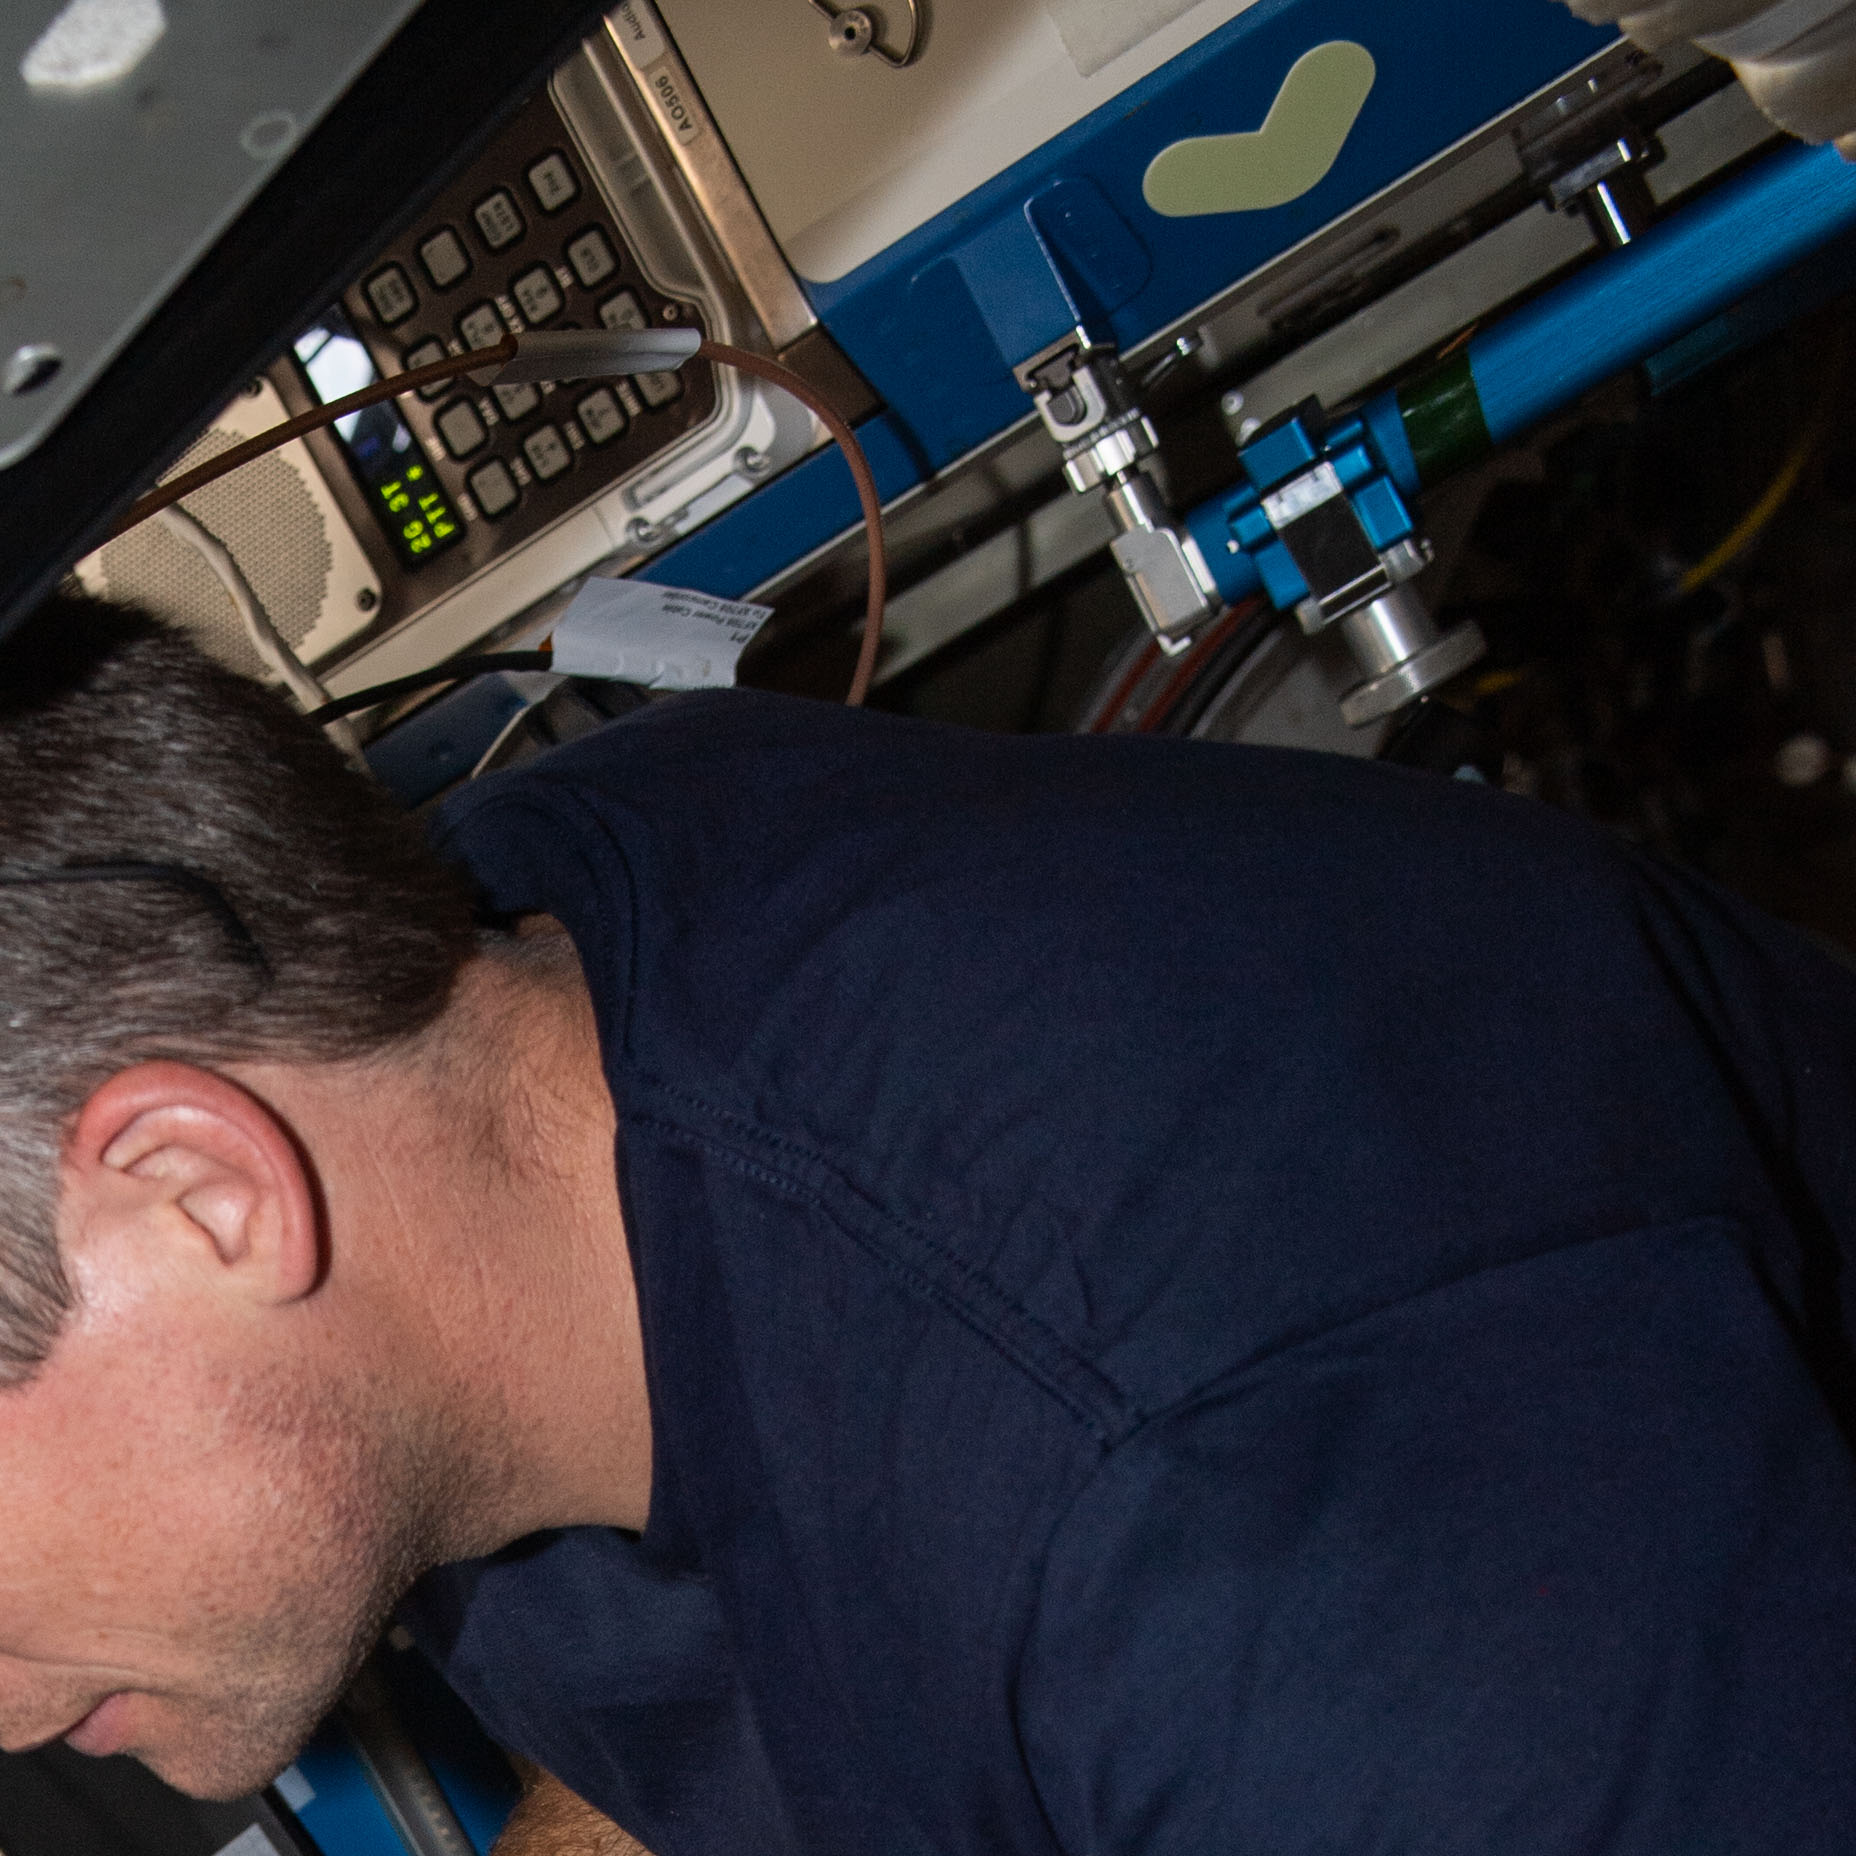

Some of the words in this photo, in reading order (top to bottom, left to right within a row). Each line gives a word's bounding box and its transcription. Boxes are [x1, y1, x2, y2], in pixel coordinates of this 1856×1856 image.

[654, 73, 694, 133] AO506
[417, 489, 456, 536] PTT
[660, 601, 692, 618] Cable
[694, 608, 725, 624] Power
